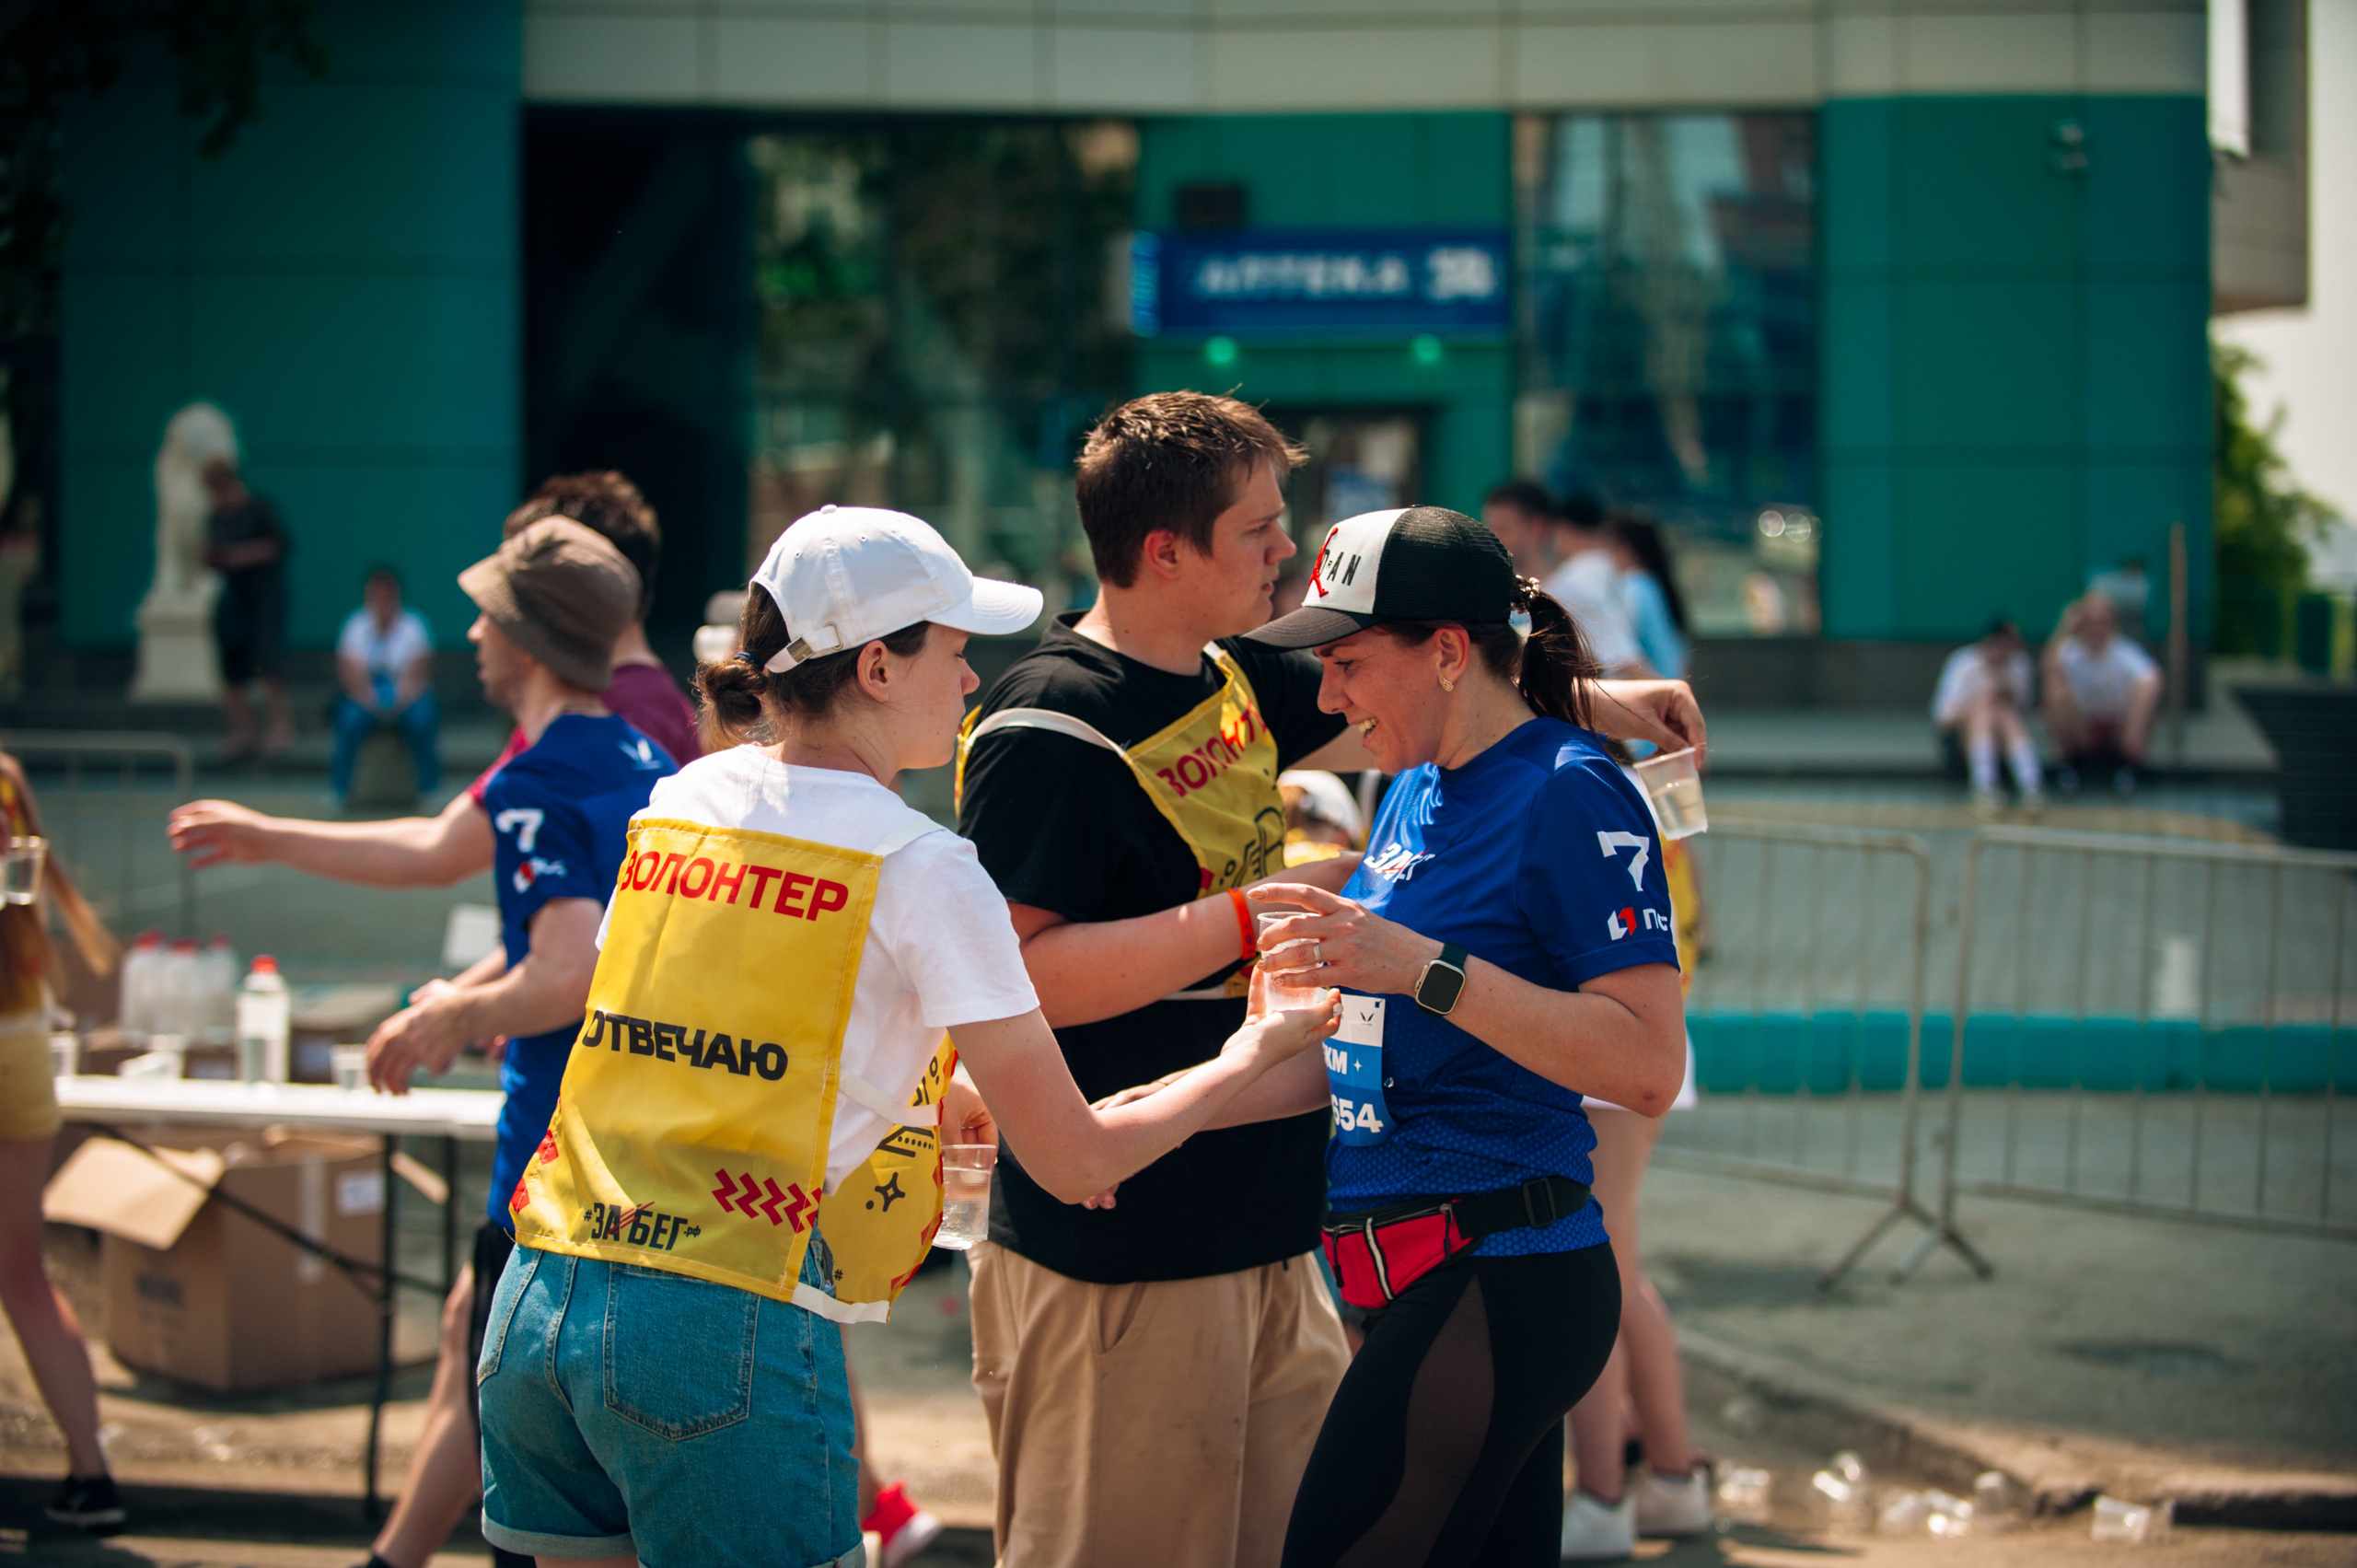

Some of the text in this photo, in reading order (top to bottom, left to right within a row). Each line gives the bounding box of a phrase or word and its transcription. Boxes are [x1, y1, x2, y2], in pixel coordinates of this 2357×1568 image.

[495, 807, 544, 853] 7
[1596, 830, 1650, 892] 7
[620, 850, 850, 922] ВОЛОНТЕР
[582, 1009, 789, 1082] ОТВЕЧАЮ
